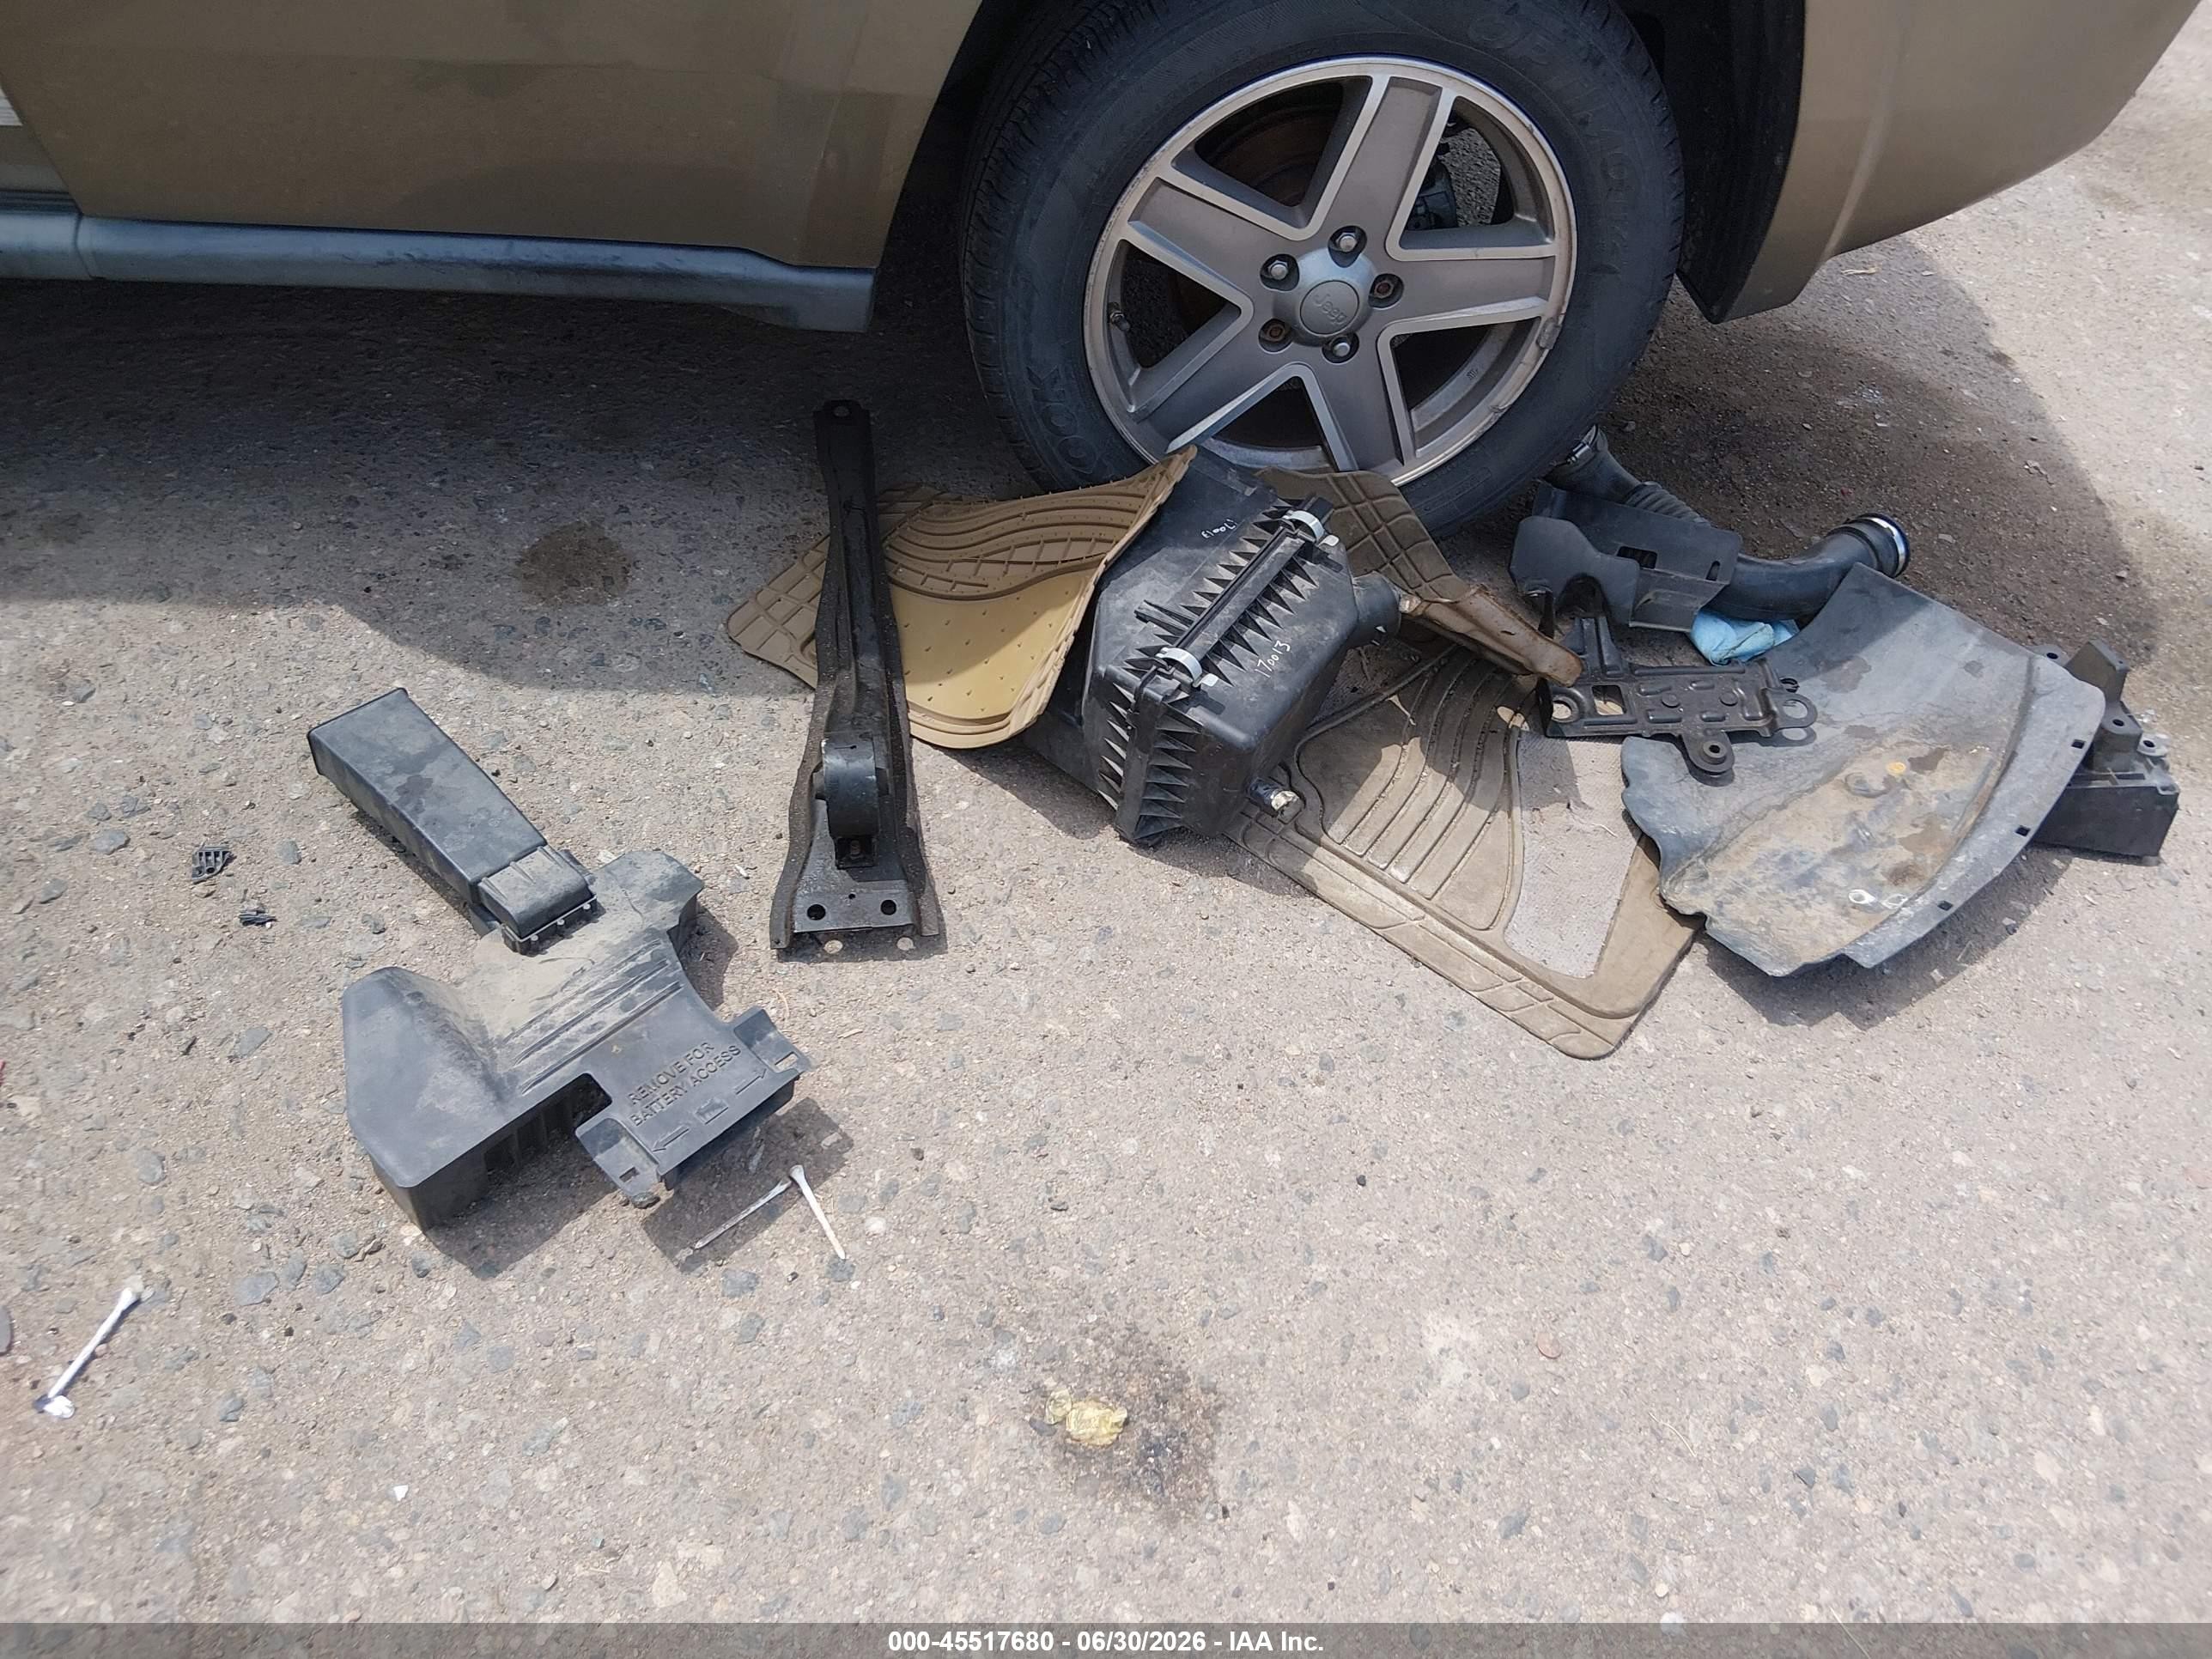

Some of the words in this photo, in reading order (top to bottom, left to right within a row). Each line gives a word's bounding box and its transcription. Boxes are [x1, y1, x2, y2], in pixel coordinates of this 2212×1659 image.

[1314, 294, 1346, 325] Jeep
[1255, 640, 1291, 678] 170013
[628, 1060, 687, 1105] REMOVE
[684, 1042, 715, 1066] FOR
[629, 1083, 688, 1127] BATTERY
[690, 1044, 741, 1087] ACCESS
